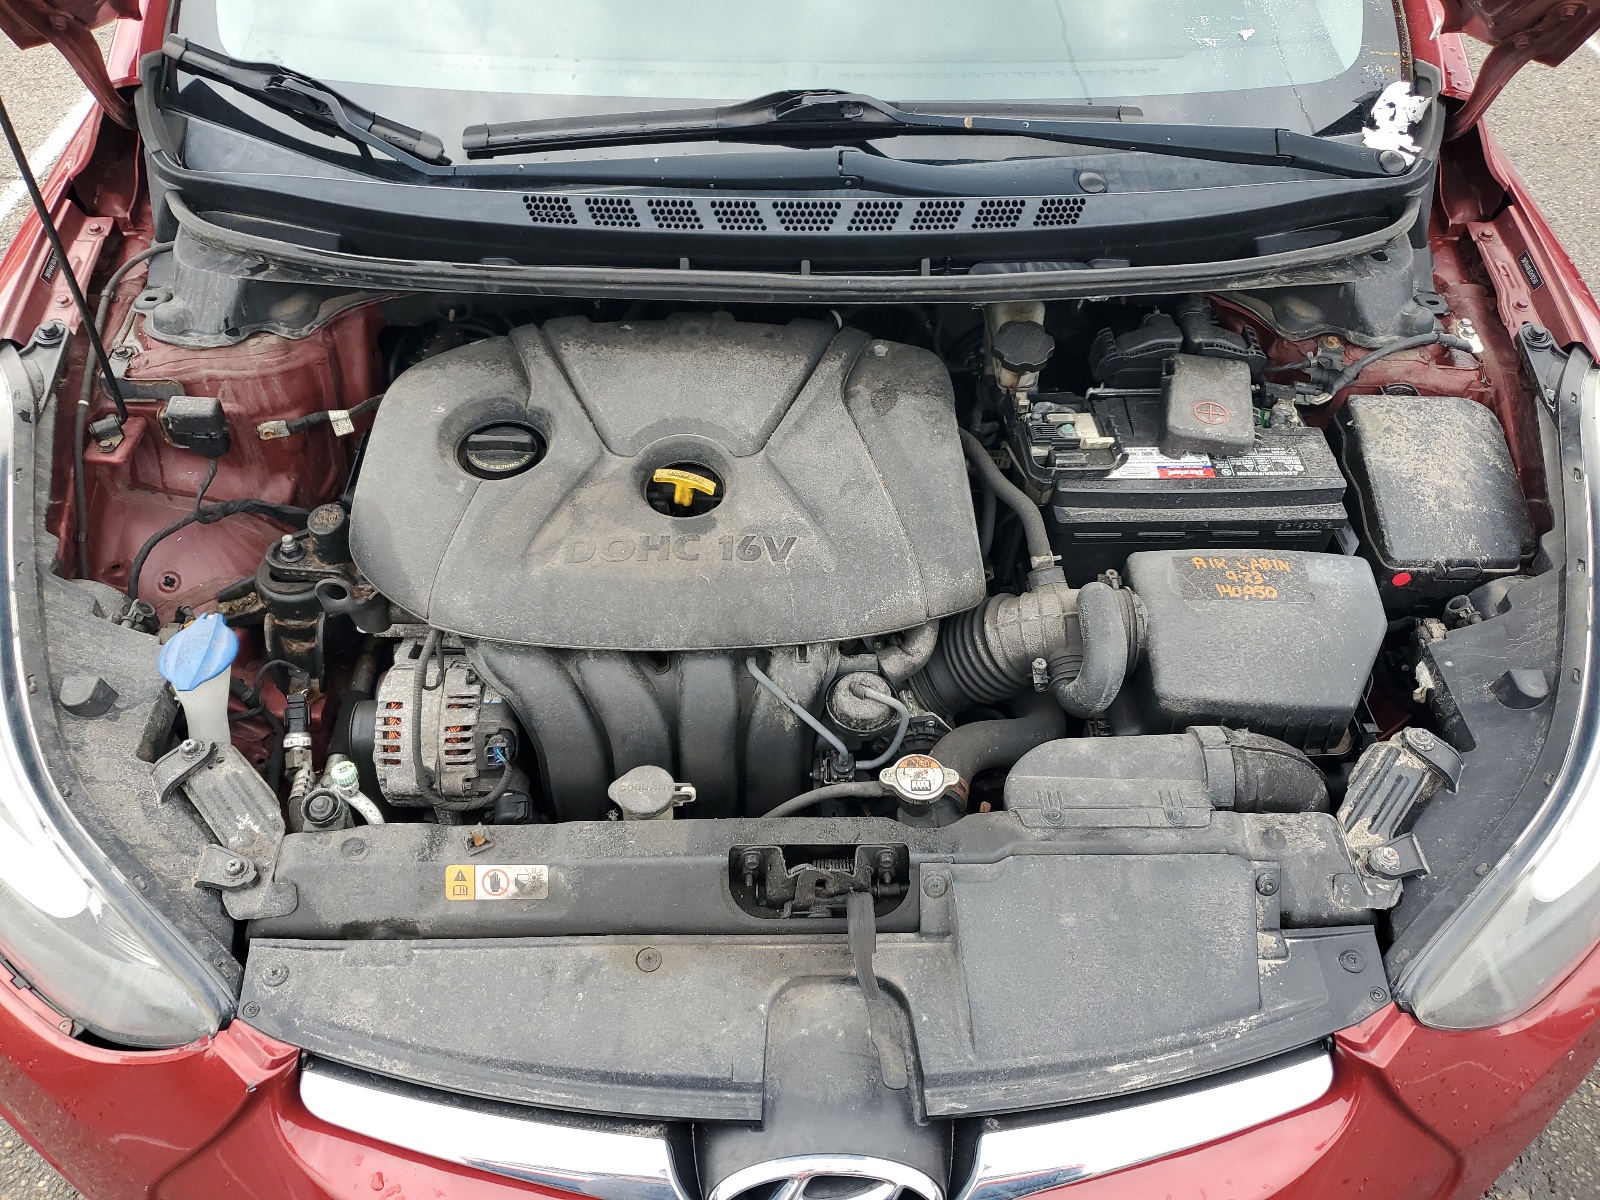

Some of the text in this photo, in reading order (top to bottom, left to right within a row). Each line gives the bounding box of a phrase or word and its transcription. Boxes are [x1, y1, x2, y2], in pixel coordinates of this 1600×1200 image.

[564, 535, 798, 564] DOHC 16V
[1191, 556, 1292, 573] AIR CABIN
[1225, 570, 1264, 585] 9-23
